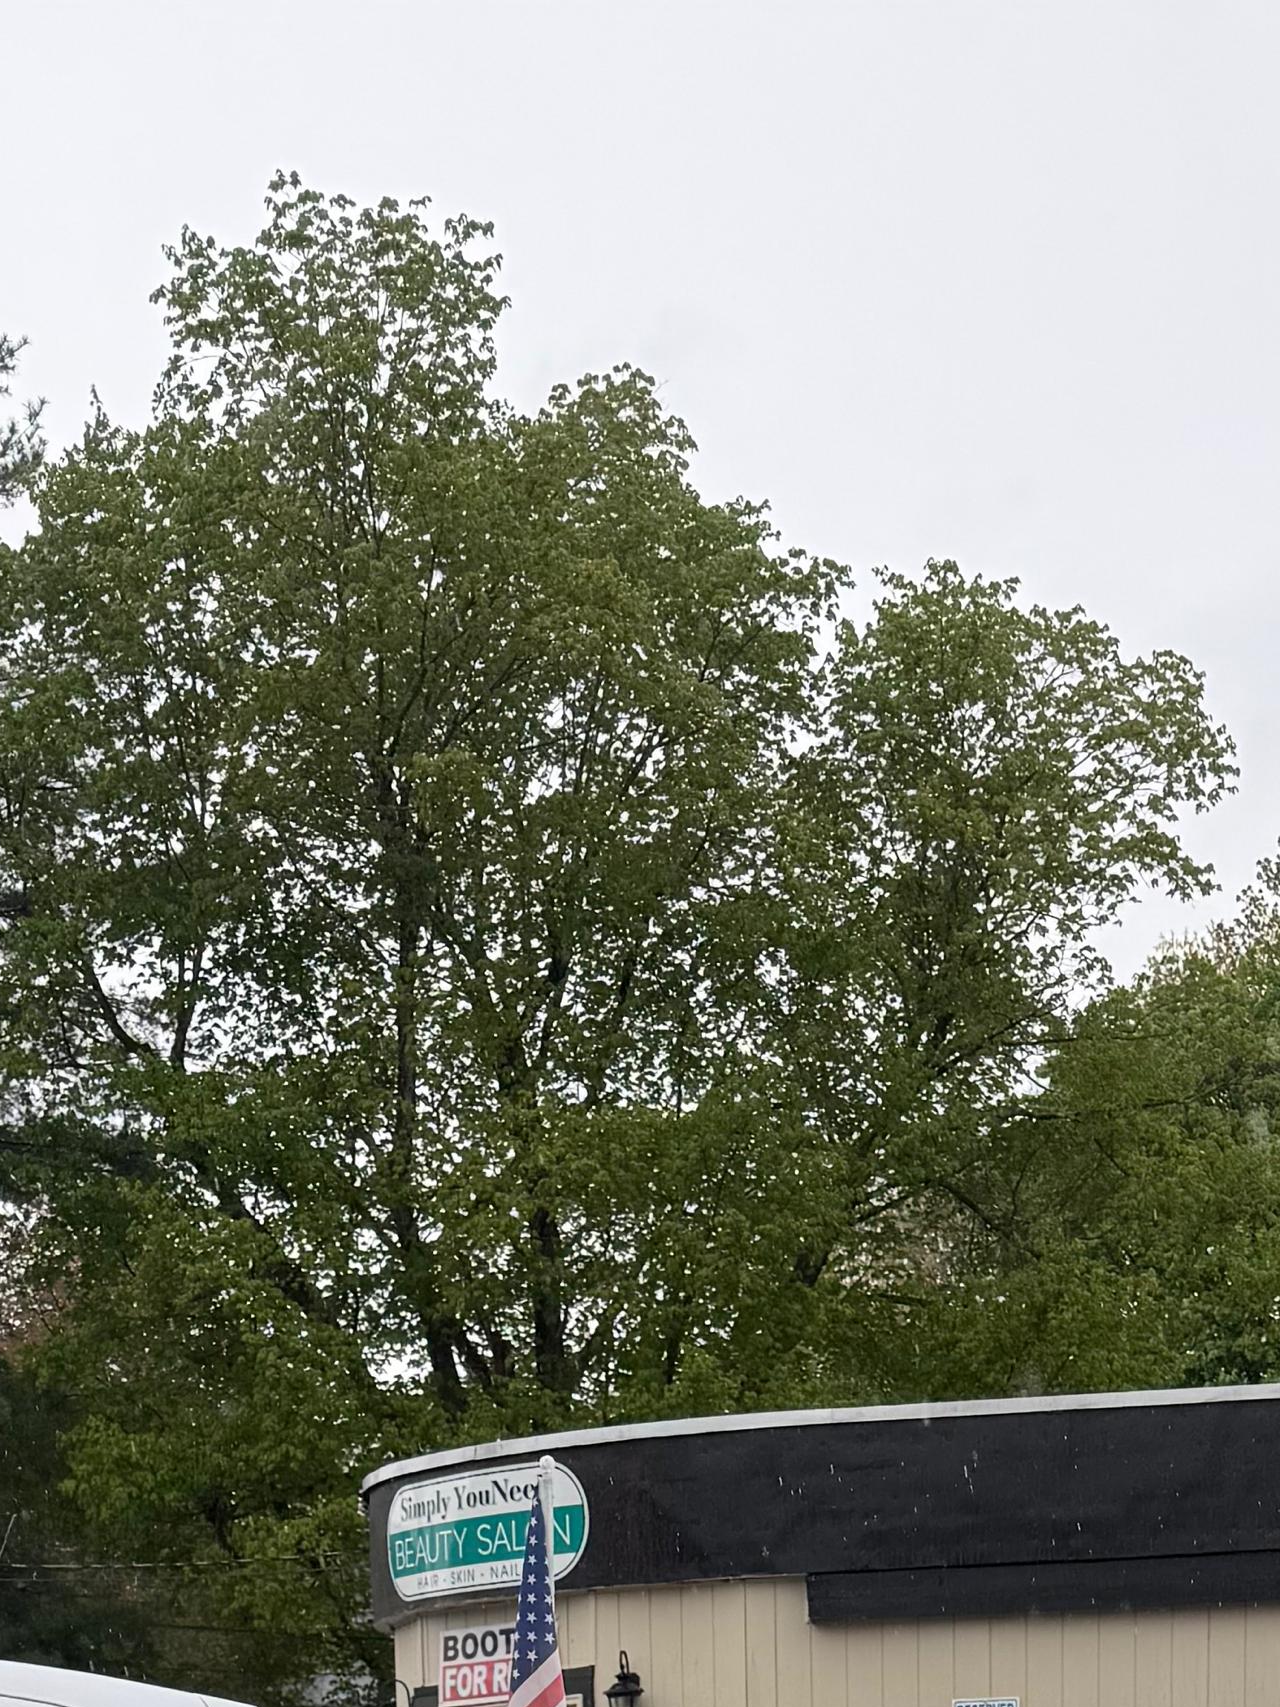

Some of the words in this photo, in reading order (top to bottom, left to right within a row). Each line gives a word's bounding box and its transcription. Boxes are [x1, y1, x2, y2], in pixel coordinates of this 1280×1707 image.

[400, 1489, 452, 1523] Simply
[454, 1473, 541, 1510] YouNee
[394, 1527, 468, 1571] BEAUTY
[476, 1513, 571, 1556] SALN
[416, 1574, 439, 1588] HAIR
[450, 1569, 476, 1586] SKIN
[489, 1563, 522, 1579] NAIL
[443, 1628, 516, 1662] BOOT
[444, 1664, 488, 1699] FOR
